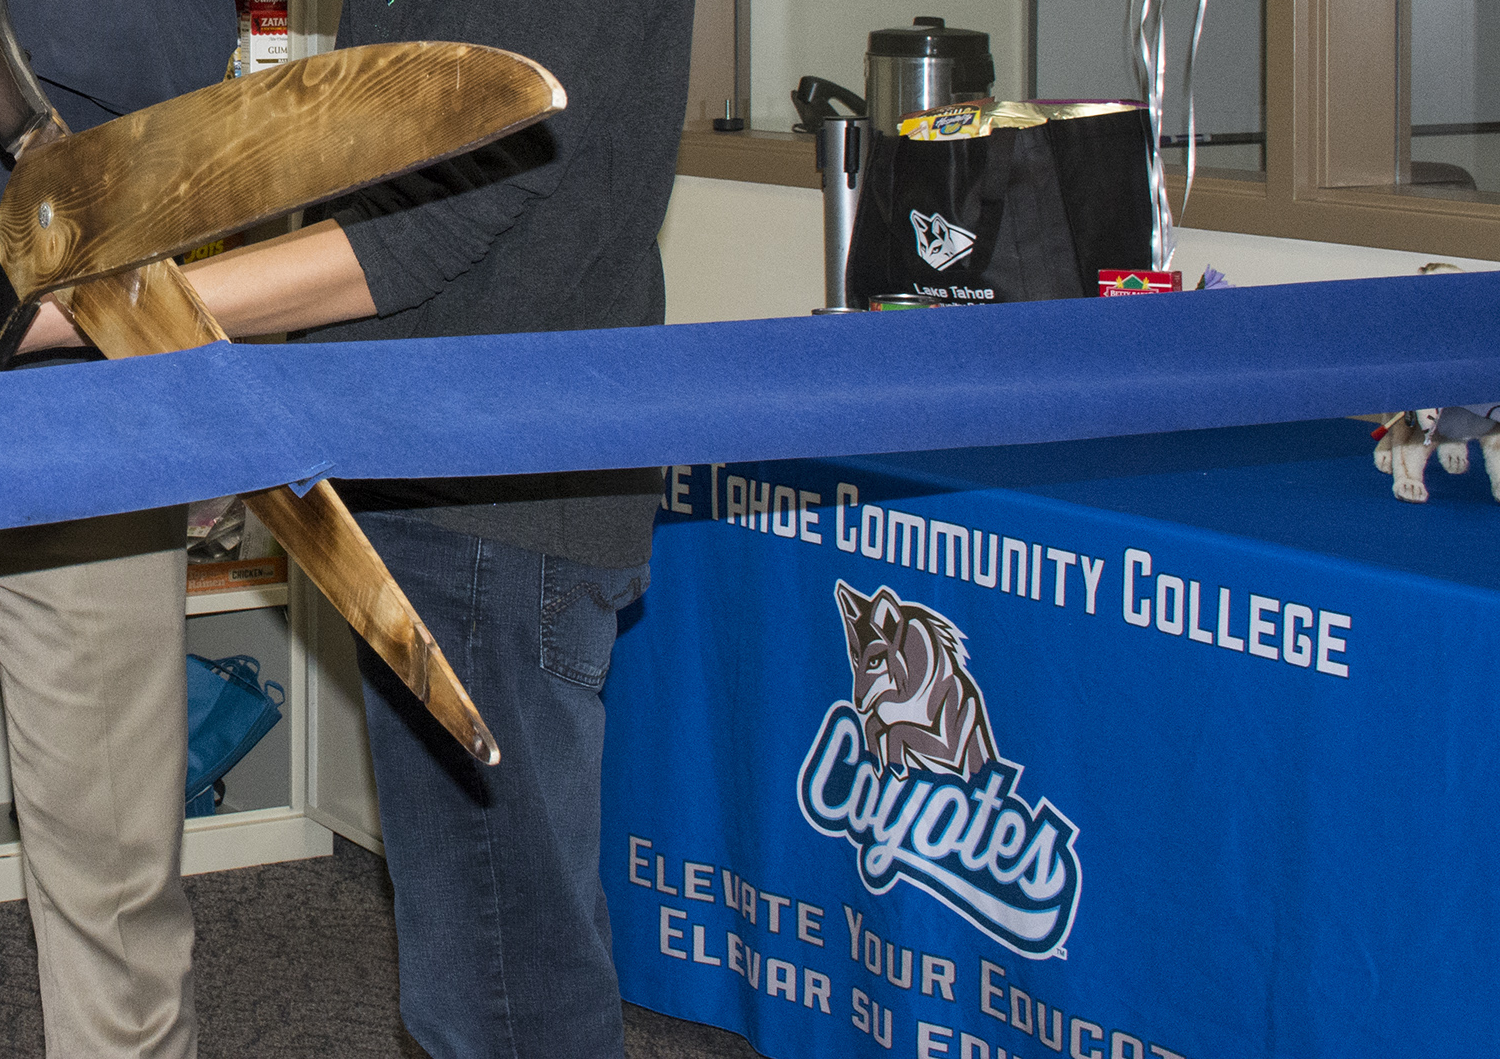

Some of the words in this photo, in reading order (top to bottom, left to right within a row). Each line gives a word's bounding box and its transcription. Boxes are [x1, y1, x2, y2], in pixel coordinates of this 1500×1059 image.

[913, 282, 948, 298] Lake
[949, 285, 995, 300] Tahoe
[231, 568, 263, 580] CHICKEN
[809, 716, 1067, 908] Coyotes
